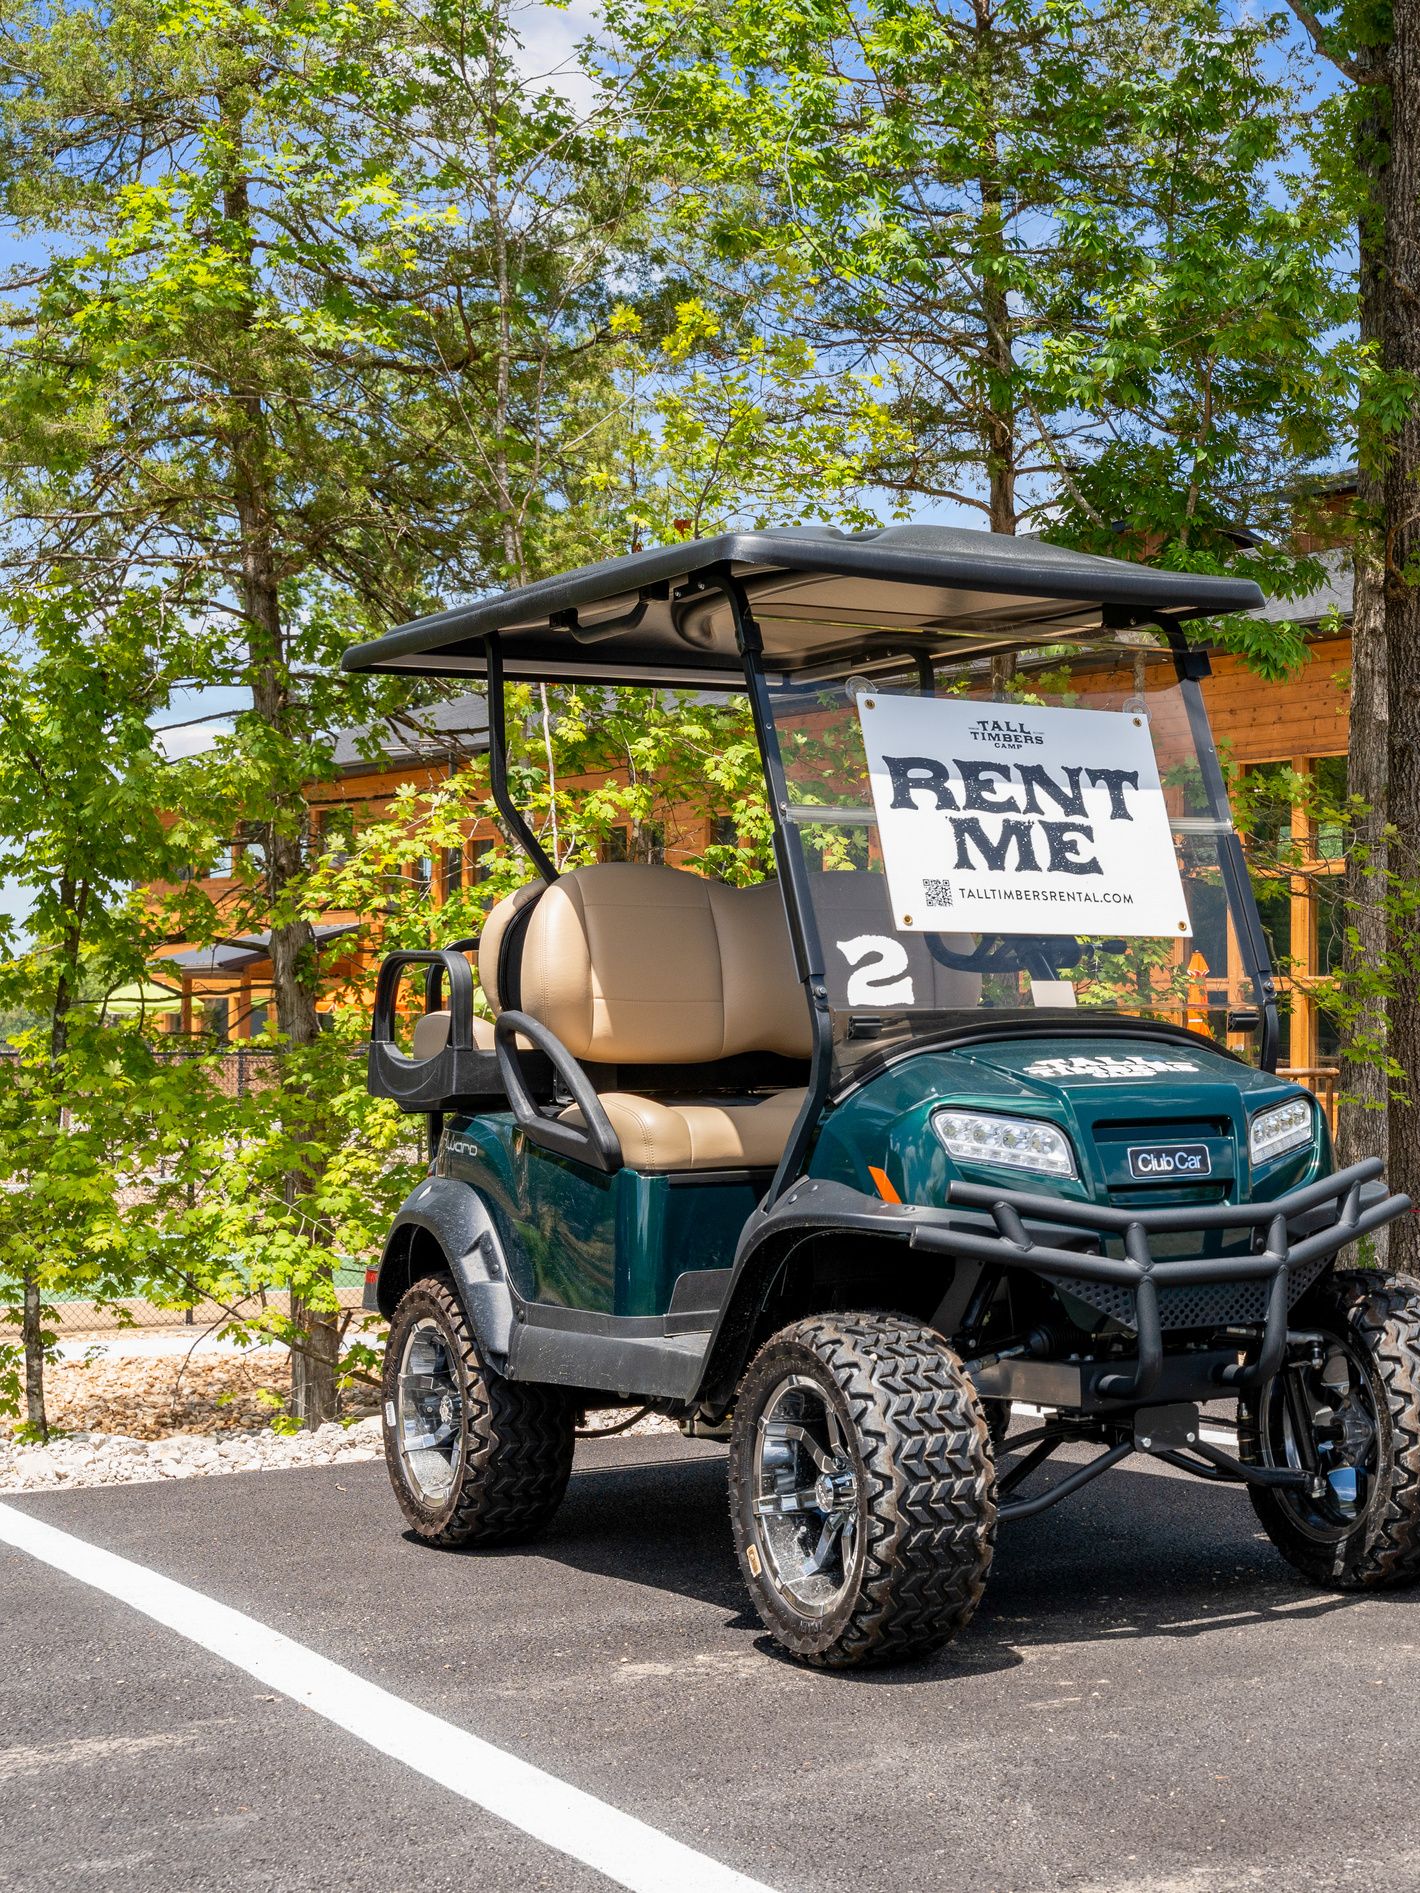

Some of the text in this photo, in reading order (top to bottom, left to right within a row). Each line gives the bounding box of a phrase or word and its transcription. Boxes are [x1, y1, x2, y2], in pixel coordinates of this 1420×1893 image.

[977, 720, 1032, 735] TALL
[970, 731, 1044, 745] TIMBERS
[994, 742, 1023, 750] CAMP
[881, 755, 1139, 822] RENT
[945, 816, 1104, 875] ME
[958, 887, 1134, 904] TALLTIMBERSRENTAL.COM
[836, 934, 915, 1007] 2
[1137, 1151, 1202, 1172] Club Car
